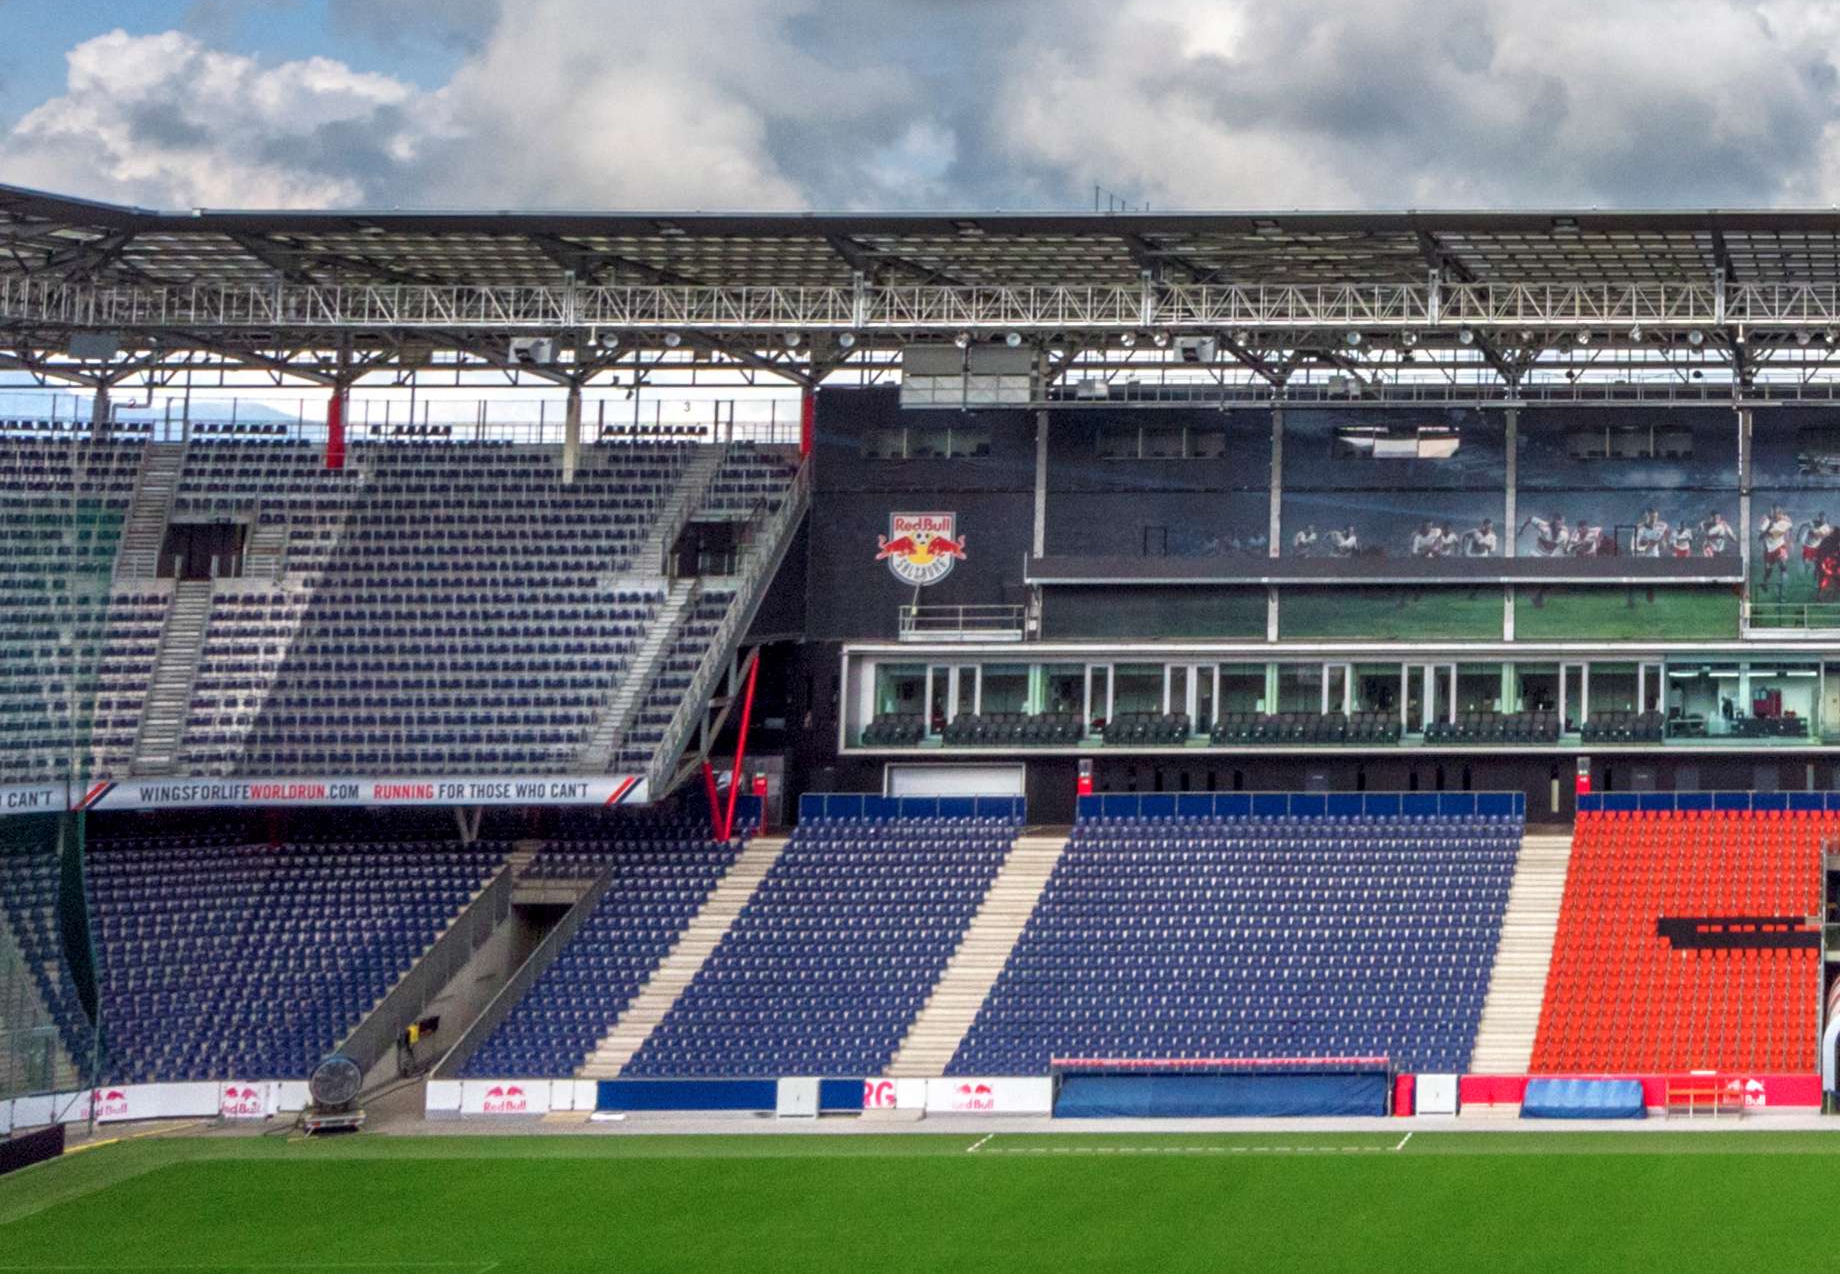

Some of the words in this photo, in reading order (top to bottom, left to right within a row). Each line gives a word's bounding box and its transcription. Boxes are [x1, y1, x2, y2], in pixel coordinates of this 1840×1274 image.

[6, 789, 54, 810] CAN'T
[139, 783, 359, 803] WINGSFORLIFEWORLDRUN.COM
[373, 783, 435, 802] RUNNING
[438, 783, 466, 801] FOR
[469, 783, 512, 800] THOSE
[515, 782, 547, 800] WHO
[549, 781, 589, 800] CAN'T
